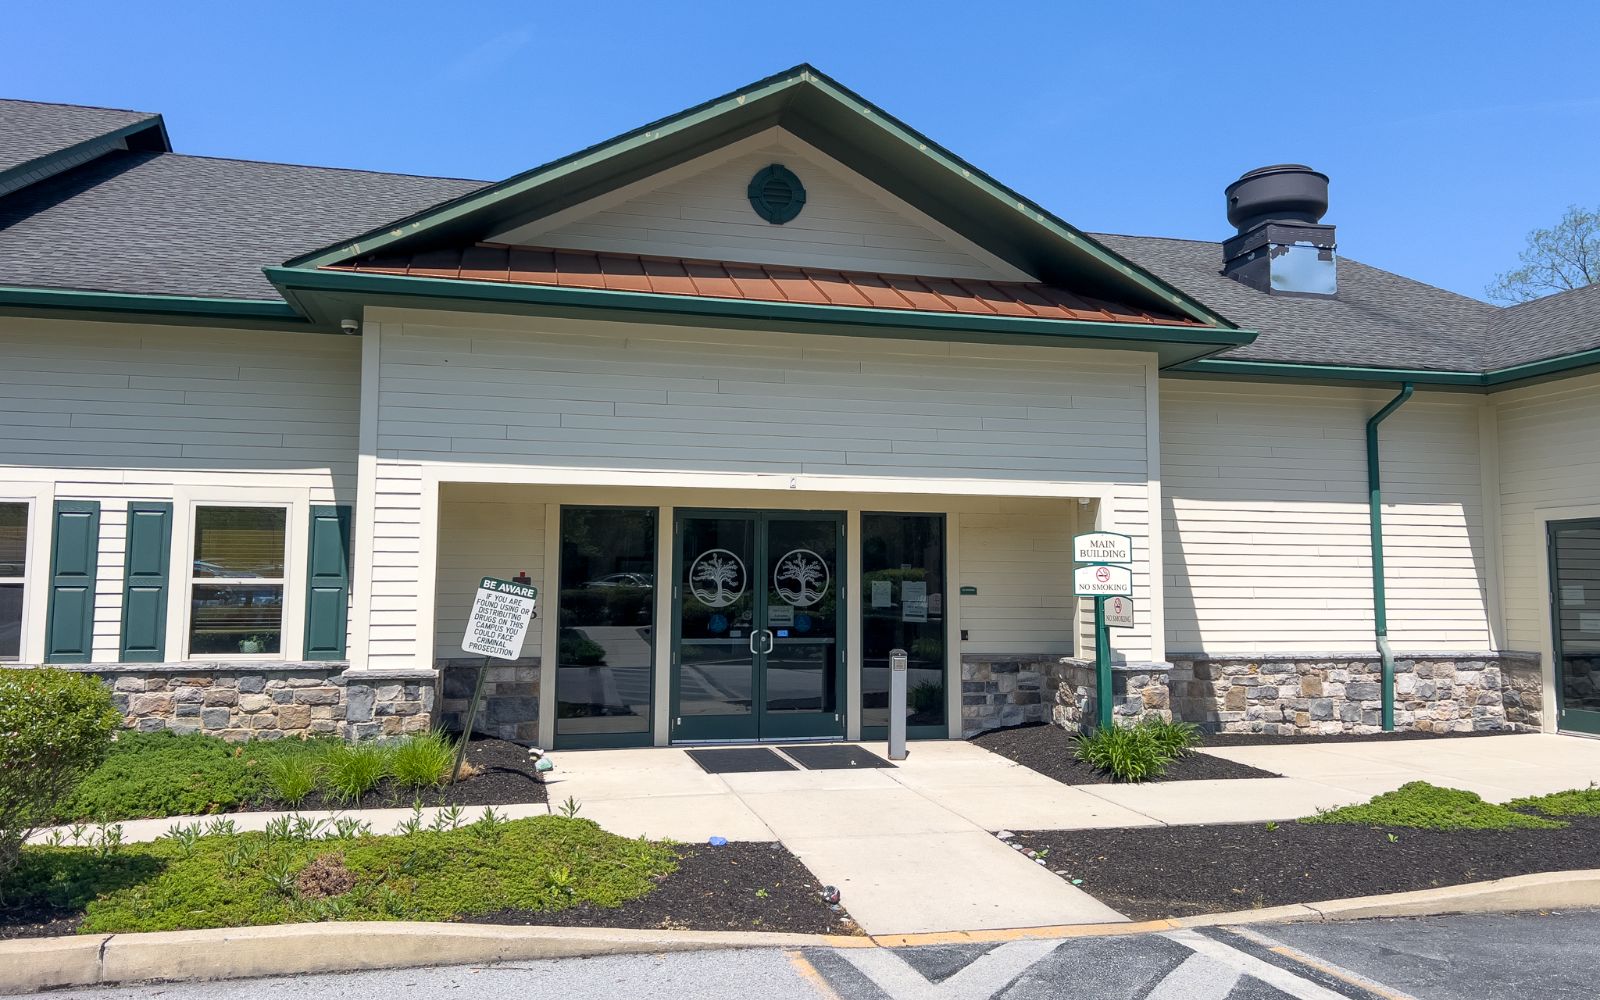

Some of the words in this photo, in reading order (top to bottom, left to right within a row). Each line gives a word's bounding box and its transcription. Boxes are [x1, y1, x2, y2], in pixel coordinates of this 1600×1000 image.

[1090, 540, 1115, 548] MAIN
[1080, 549, 1126, 558] BUILDING
[483, 579, 497, 589] BE
[498, 583, 534, 598] AWARE
[476, 598, 498, 608] FOUND
[500, 603, 519, 613] USING
[494, 594, 508, 603] YOU
[508, 598, 523, 606] ARE
[478, 606, 522, 621] DISTRIBUTING
[474, 613, 496, 624] DRUGS
[510, 620, 524, 629] THIS
[475, 621, 503, 632] CAMPUS
[506, 626, 518, 635] YOU
[474, 628, 495, 638] COULD
[497, 633, 514, 642] FACE
[476, 636, 507, 648] CRIMINAL
[468, 642, 513, 657] PROSECUTION
